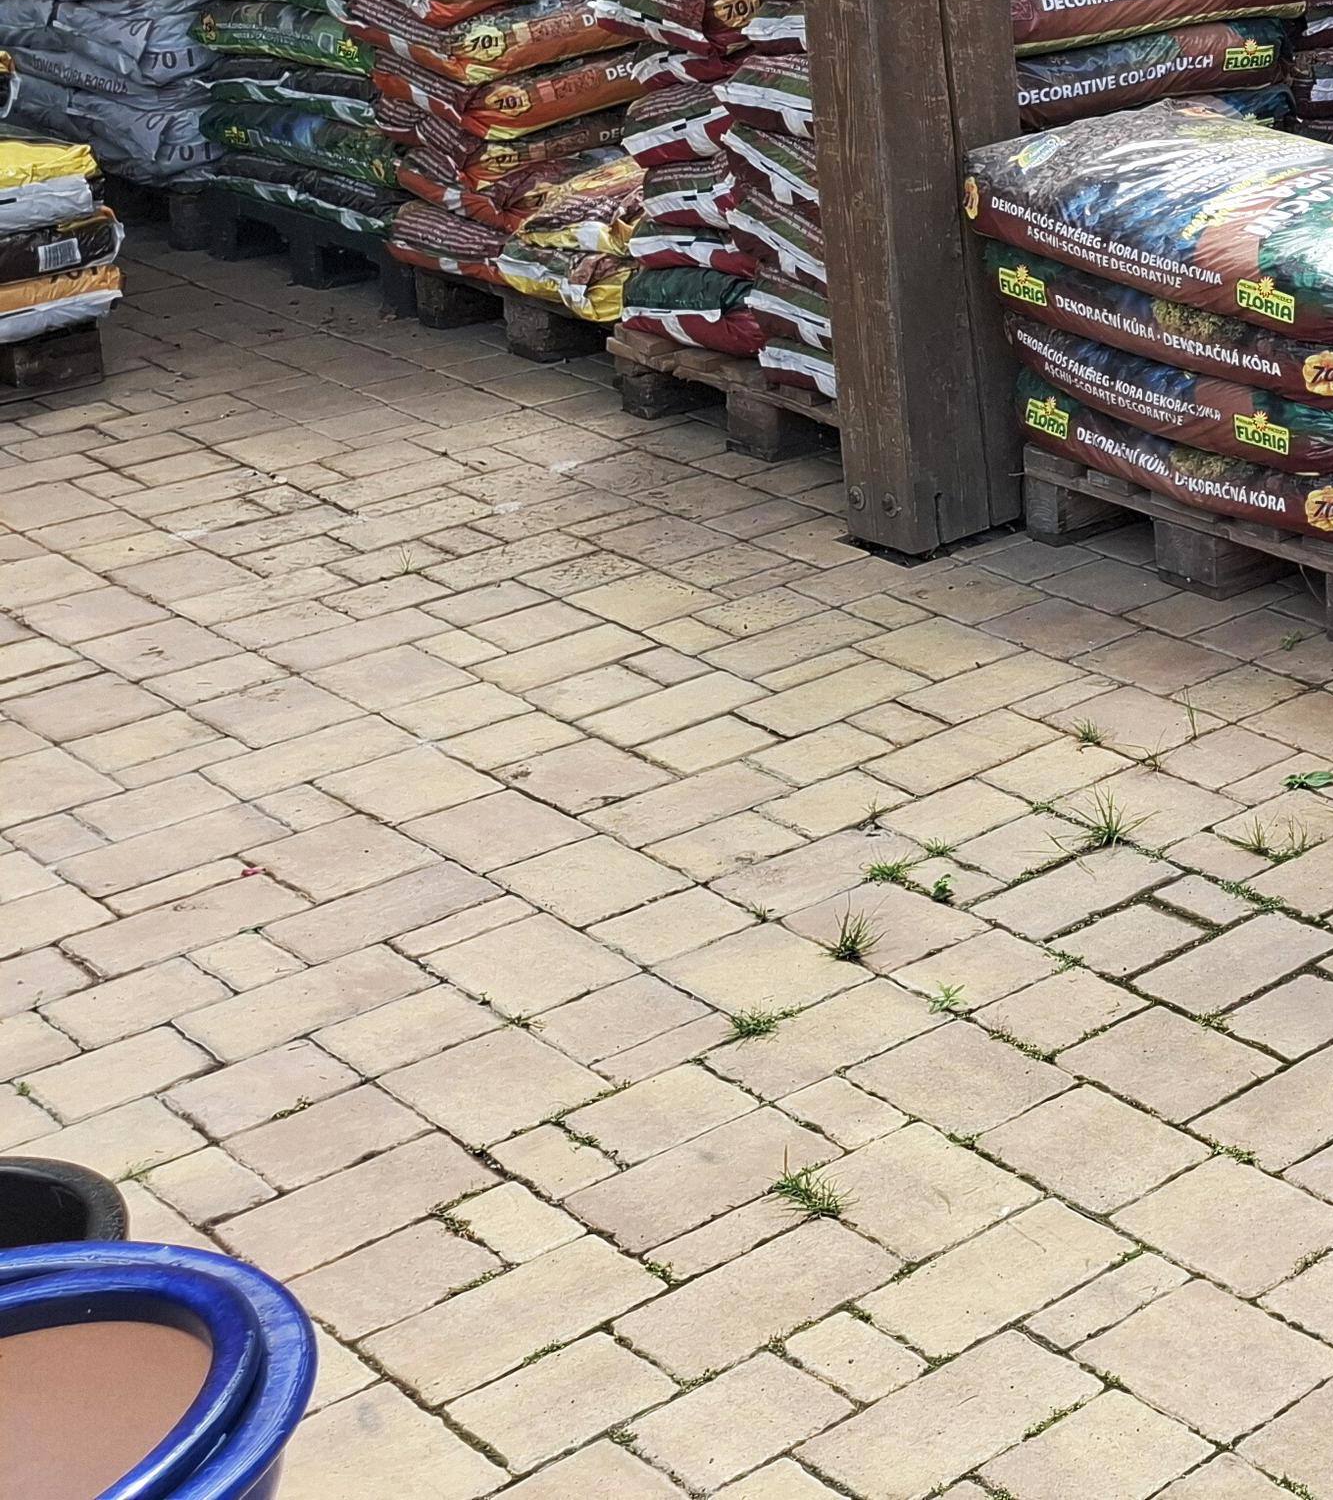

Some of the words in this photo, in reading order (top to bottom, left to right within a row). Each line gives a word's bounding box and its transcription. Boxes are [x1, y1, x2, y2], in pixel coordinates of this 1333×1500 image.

[991, 196, 1054, 232] DEKORÁCIÓS
[1054, 215, 1102, 249] FAKÉREG
[1108, 240, 1138, 260] KORA
[1111, 257, 1183, 289] DECORATIVE
[1000, 277, 1047, 306] FLORIA
[1238, 291, 1294, 323] FLORIA
[1055, 293, 1121, 330] DEKORAČNÍ
[1122, 313, 1155, 341] KŮRA
[1242, 351, 1281, 377] KÔRA
